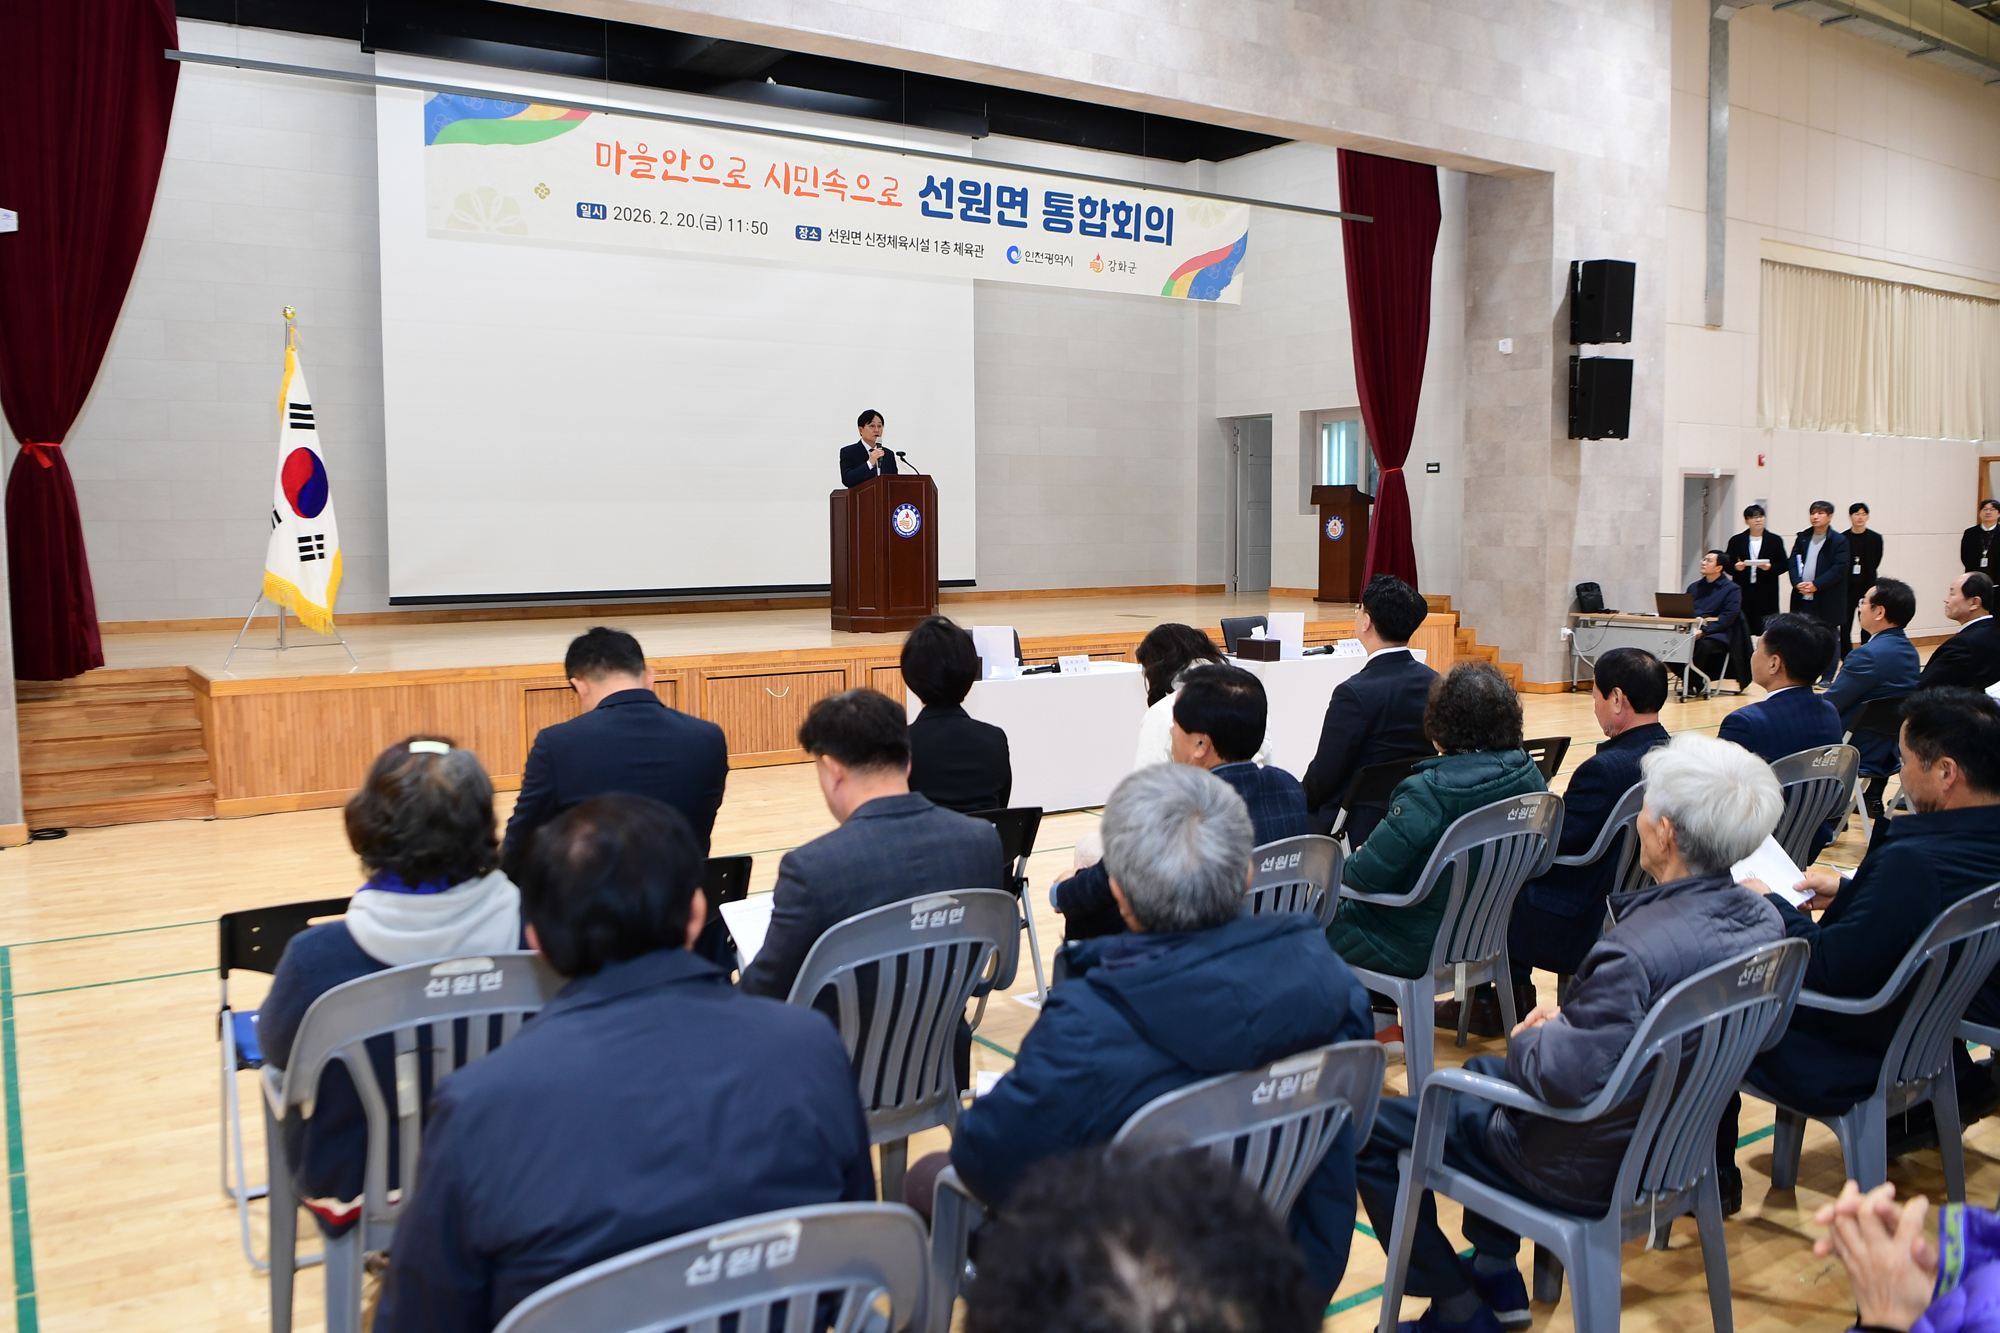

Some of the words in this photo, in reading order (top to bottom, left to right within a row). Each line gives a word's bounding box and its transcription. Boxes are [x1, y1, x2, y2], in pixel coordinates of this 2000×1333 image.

[596, 140, 752, 189] 마을안으로
[764, 161, 903, 207] 시민속으로
[918, 174, 1029, 229] 선원면
[1042, 190, 1174, 246] 통합회의
[580, 203, 603, 219] 일시
[613, 206, 656, 224] 2026.
[660, 210, 673, 226] 2.
[727, 218, 768, 236] 11:50
[798, 227, 819, 240] 장소
[827, 228, 862, 246] 선원면
[864, 231, 930, 253] 신정체육시설
[933, 240, 951, 255] 1층
[953, 241, 985, 259] 체육관
[1024, 250, 1074, 267] 인천광역시
[1108, 259, 1138, 275] 강화군
[1507, 804, 1539, 821] 선원면
[1260, 851, 1302, 873] 선원면
[910, 905, 966, 931] 선원면
[423, 969, 504, 998] 선원면
[1252, 1065, 1322, 1105] 선원면
[684, 1236, 800, 1287] 선원면
